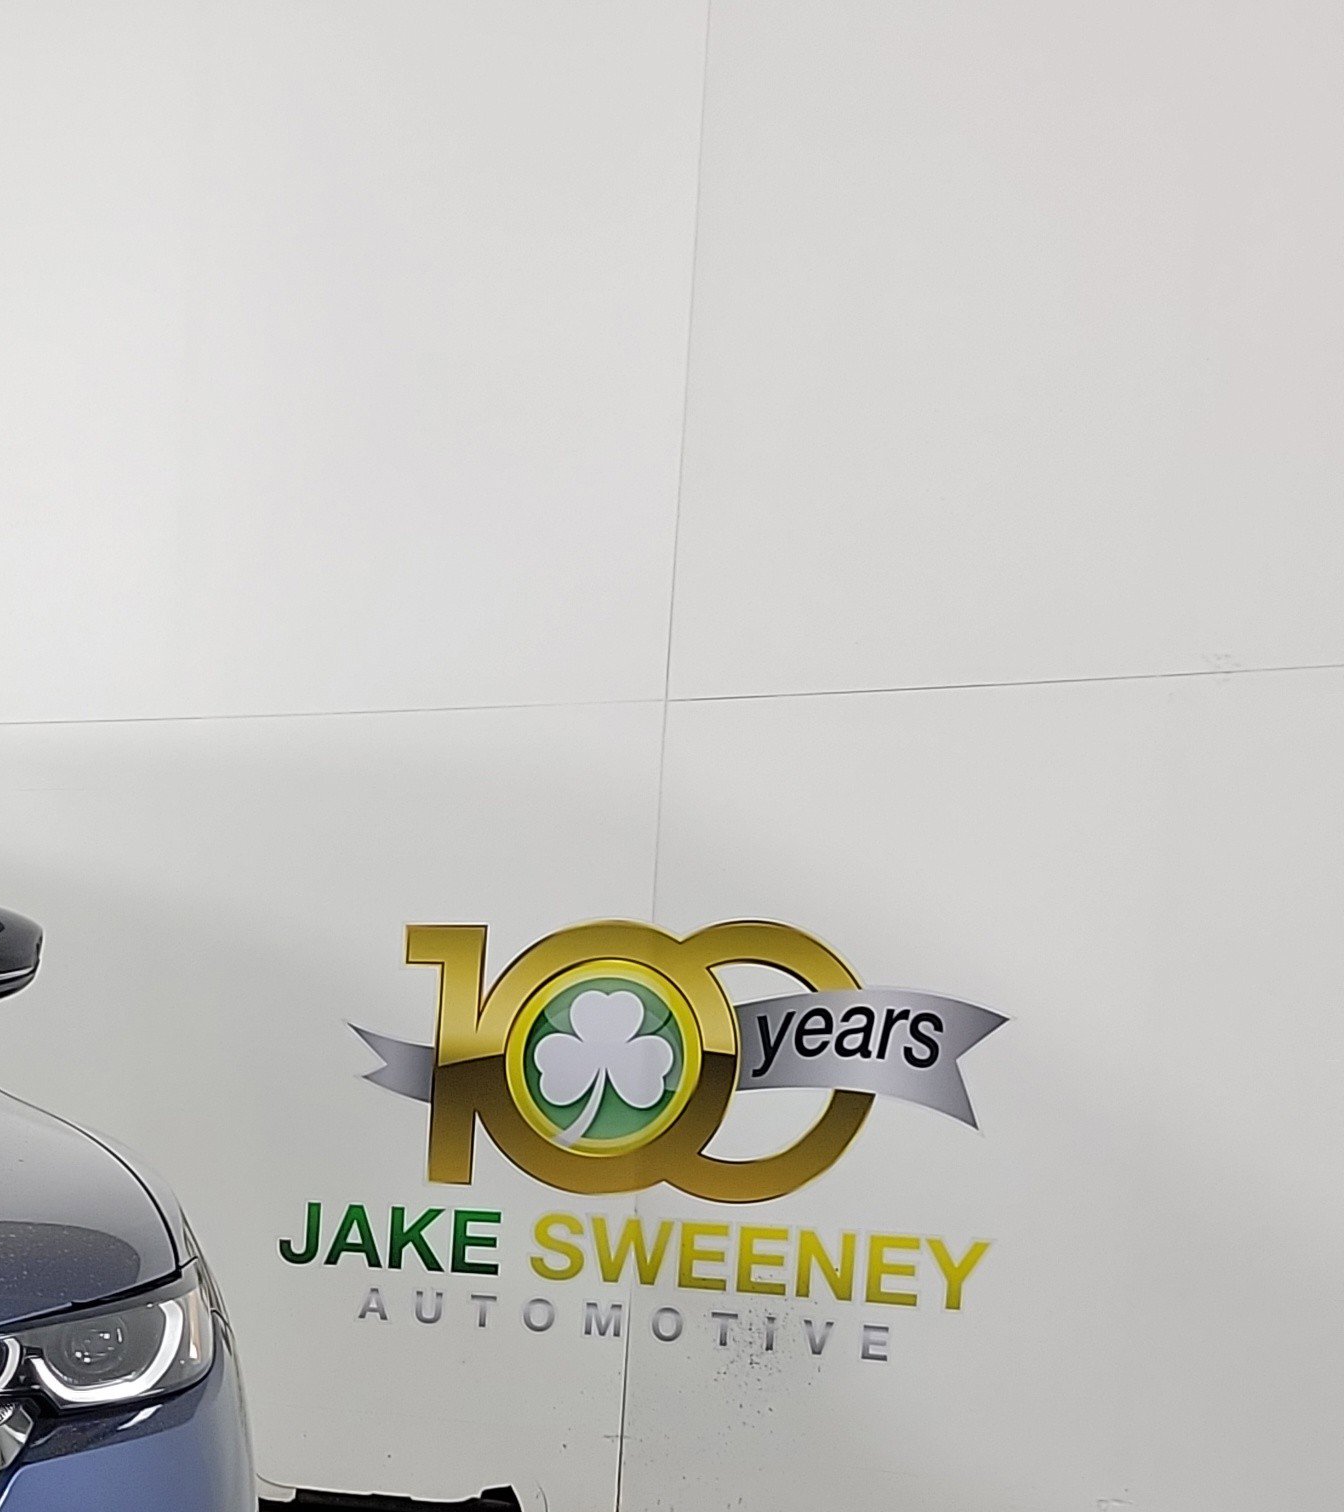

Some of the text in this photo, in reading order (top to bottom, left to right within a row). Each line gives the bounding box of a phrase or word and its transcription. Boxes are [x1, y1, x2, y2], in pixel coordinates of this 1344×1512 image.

[404, 920, 944, 1203] 100 years
[279, 1202, 991, 1310] JAKE SWEENEY
[359, 1288, 890, 1361] AUTOMOTIVE
